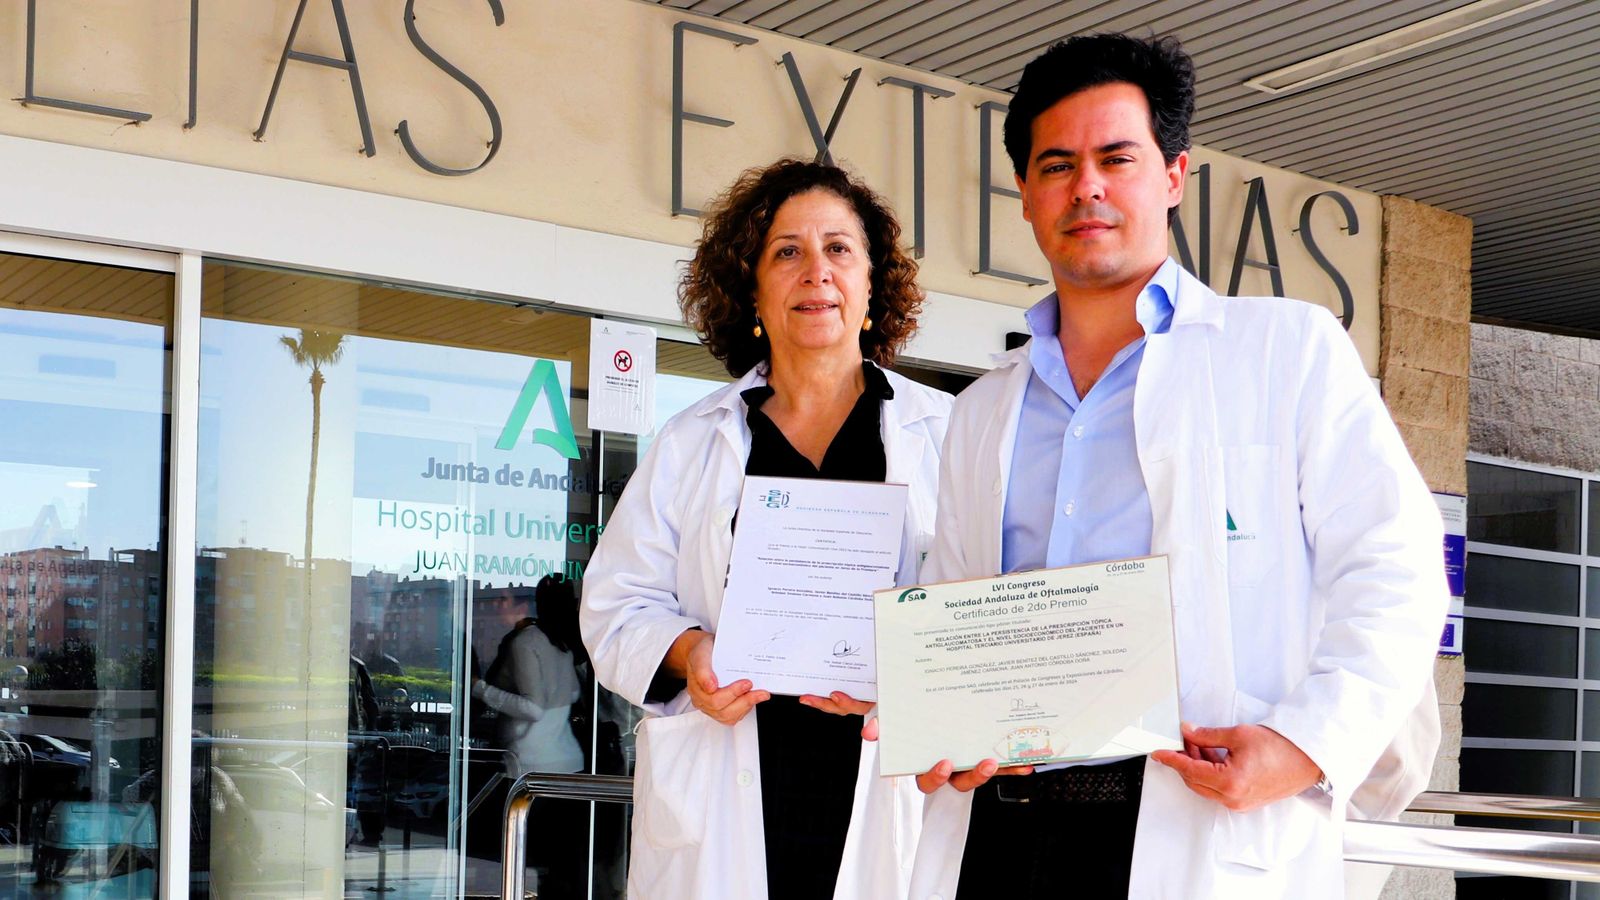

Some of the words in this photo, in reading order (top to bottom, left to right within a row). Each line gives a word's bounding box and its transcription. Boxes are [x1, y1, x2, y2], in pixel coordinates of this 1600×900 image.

[672, 21, 1359, 330] EXTENAS
[422, 458, 490, 484] Junta
[495, 463, 524, 487] de
[378, 500, 496, 540] Hospital
[413, 550, 468, 574] JUAN
[474, 552, 555, 582] RAMÓN
[1105, 560, 1145, 573] Córdoba
[992, 583, 1005, 592] LVI
[1007, 579, 1046, 591] Congreso
[944, 597, 982, 609] Sociedad
[984, 592, 1025, 604] Andaluza
[1027, 591, 1038, 599] de
[1040, 583, 1099, 599] Oftalmología
[953, 605, 1009, 621] Certificado
[1011, 604, 1024, 614] de
[1027, 601, 1047, 612] 2do
[1050, 596, 1088, 609] Premio
[991, 627, 1030, 636] PERSISTENCIA
[1077, 624, 1105, 632] PACIENTE
[946, 644, 973, 652] HOSPITAL
[974, 641, 1003, 649] TERCIARIO
[1004, 636, 1046, 645] UNIVERSITARIO
[1049, 653, 1075, 662] CASTILLO
[1102, 647, 1127, 655] SOLEDAD
